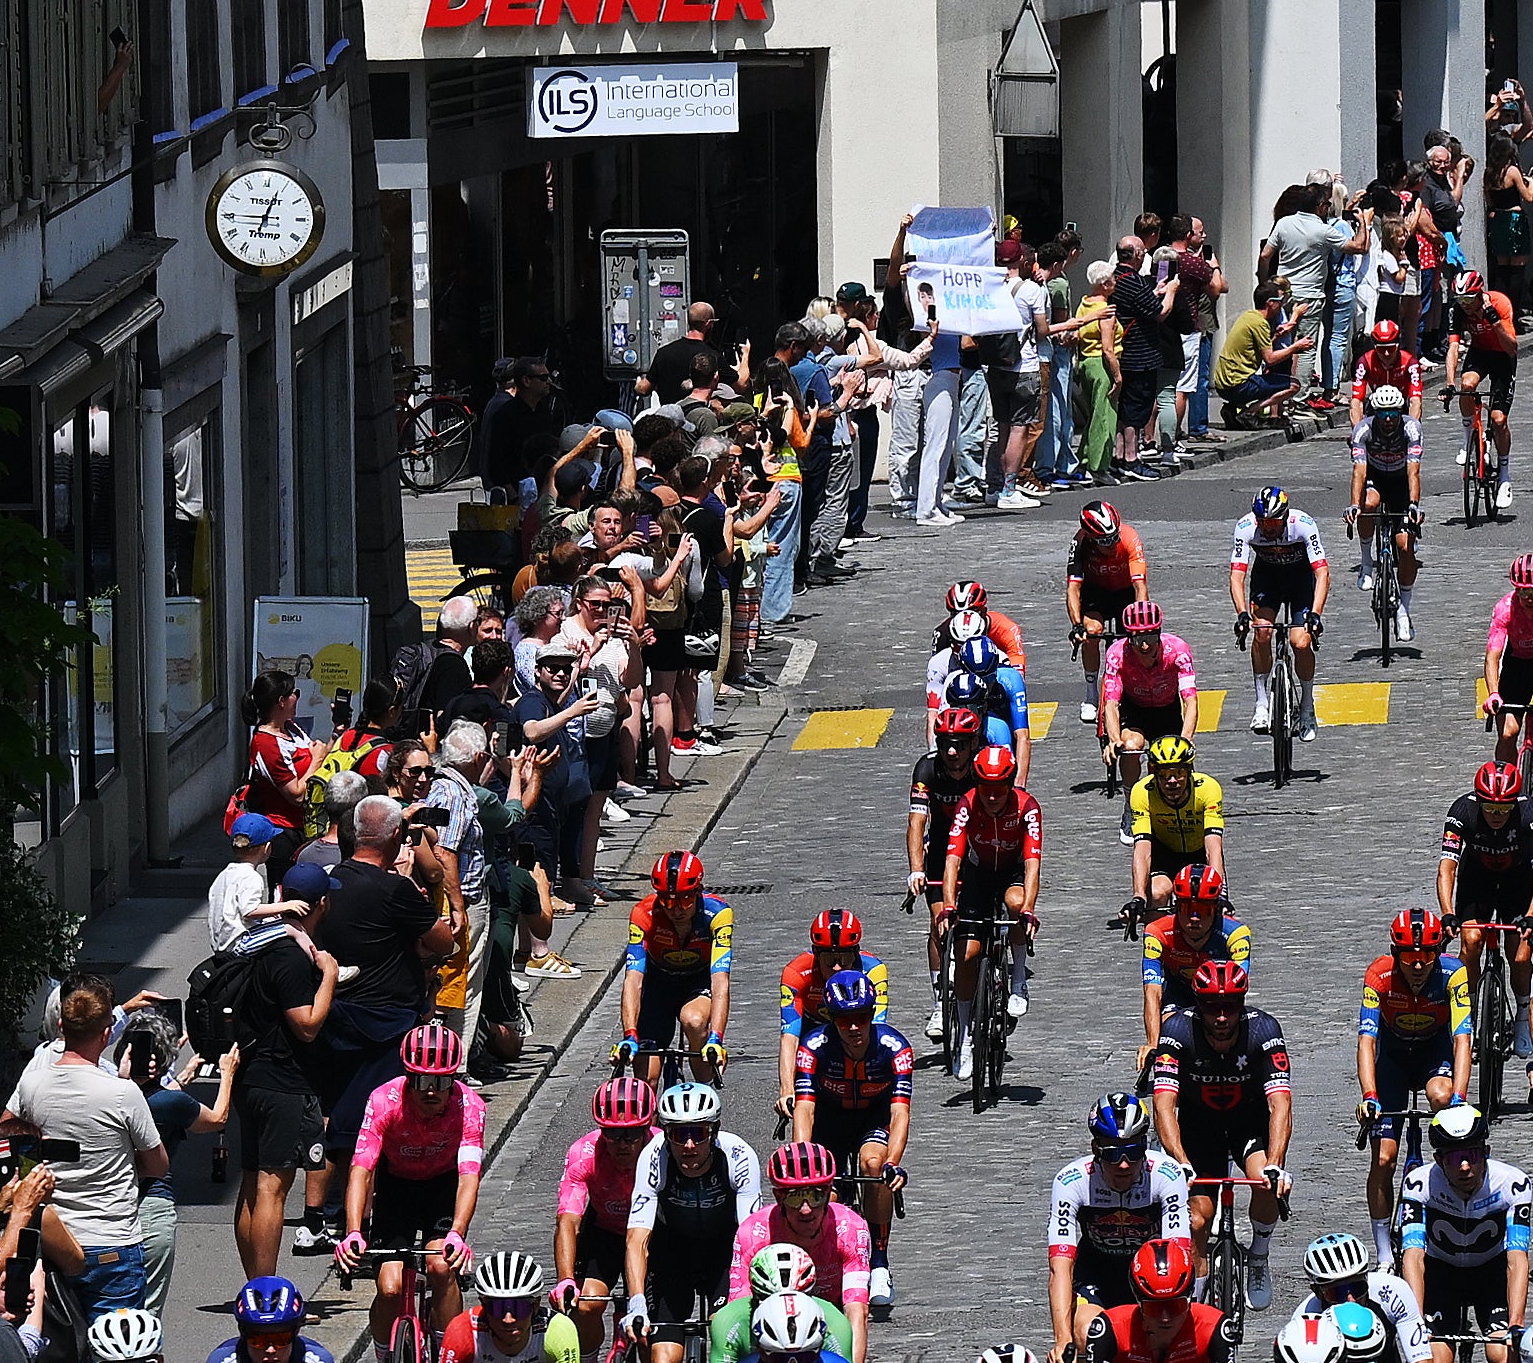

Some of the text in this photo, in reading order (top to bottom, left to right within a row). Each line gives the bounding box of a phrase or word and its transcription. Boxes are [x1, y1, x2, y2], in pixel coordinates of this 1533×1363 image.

[607, 81, 734, 100] International
[549, 90, 589, 115] ILS
[607, 103, 735, 121] Language School
[250, 198, 282, 206] TISSOT
[944, 268, 982, 287] HOPP
[1309, 532, 1324, 557] BOSS
[1159, 1036, 1183, 1049] BMC
[1262, 1039, 1286, 1051] BMC
[1189, 1073, 1252, 1085] TUDOR
[1056, 1166, 1079, 1180] BORA
[1057, 1200, 1070, 1238] BOSS
[1167, 1193, 1180, 1231] BOSS
